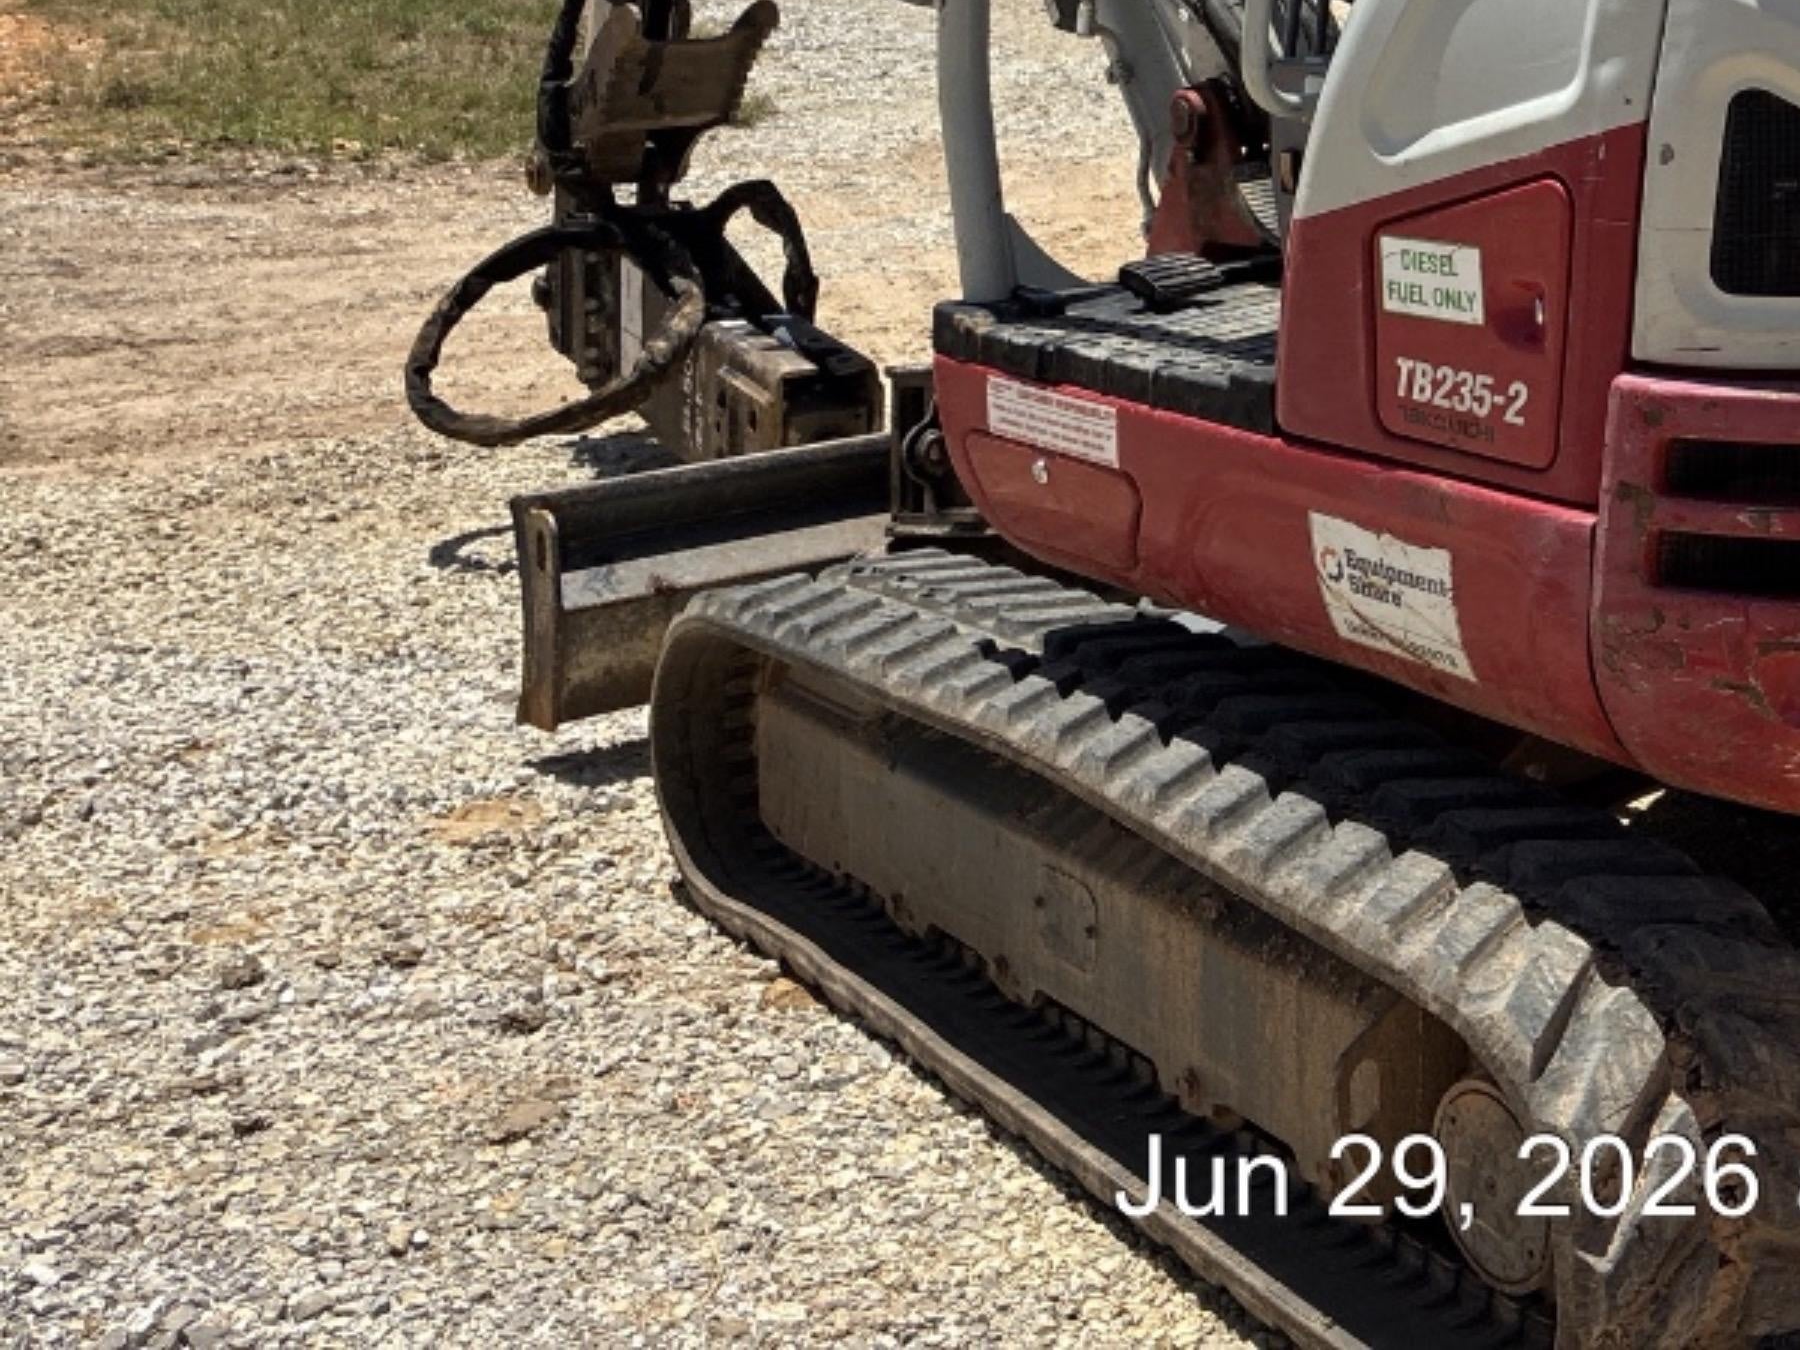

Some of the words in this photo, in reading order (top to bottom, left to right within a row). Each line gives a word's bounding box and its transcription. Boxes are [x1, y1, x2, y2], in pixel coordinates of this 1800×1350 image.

[1401, 248, 1459, 277] DIESEL
[1388, 280, 1429, 306] FUEL
[1434, 287, 1477, 313] ONLY
[1396, 356, 1529, 427] TB235-2
[1345, 548, 1448, 597] Equipment
